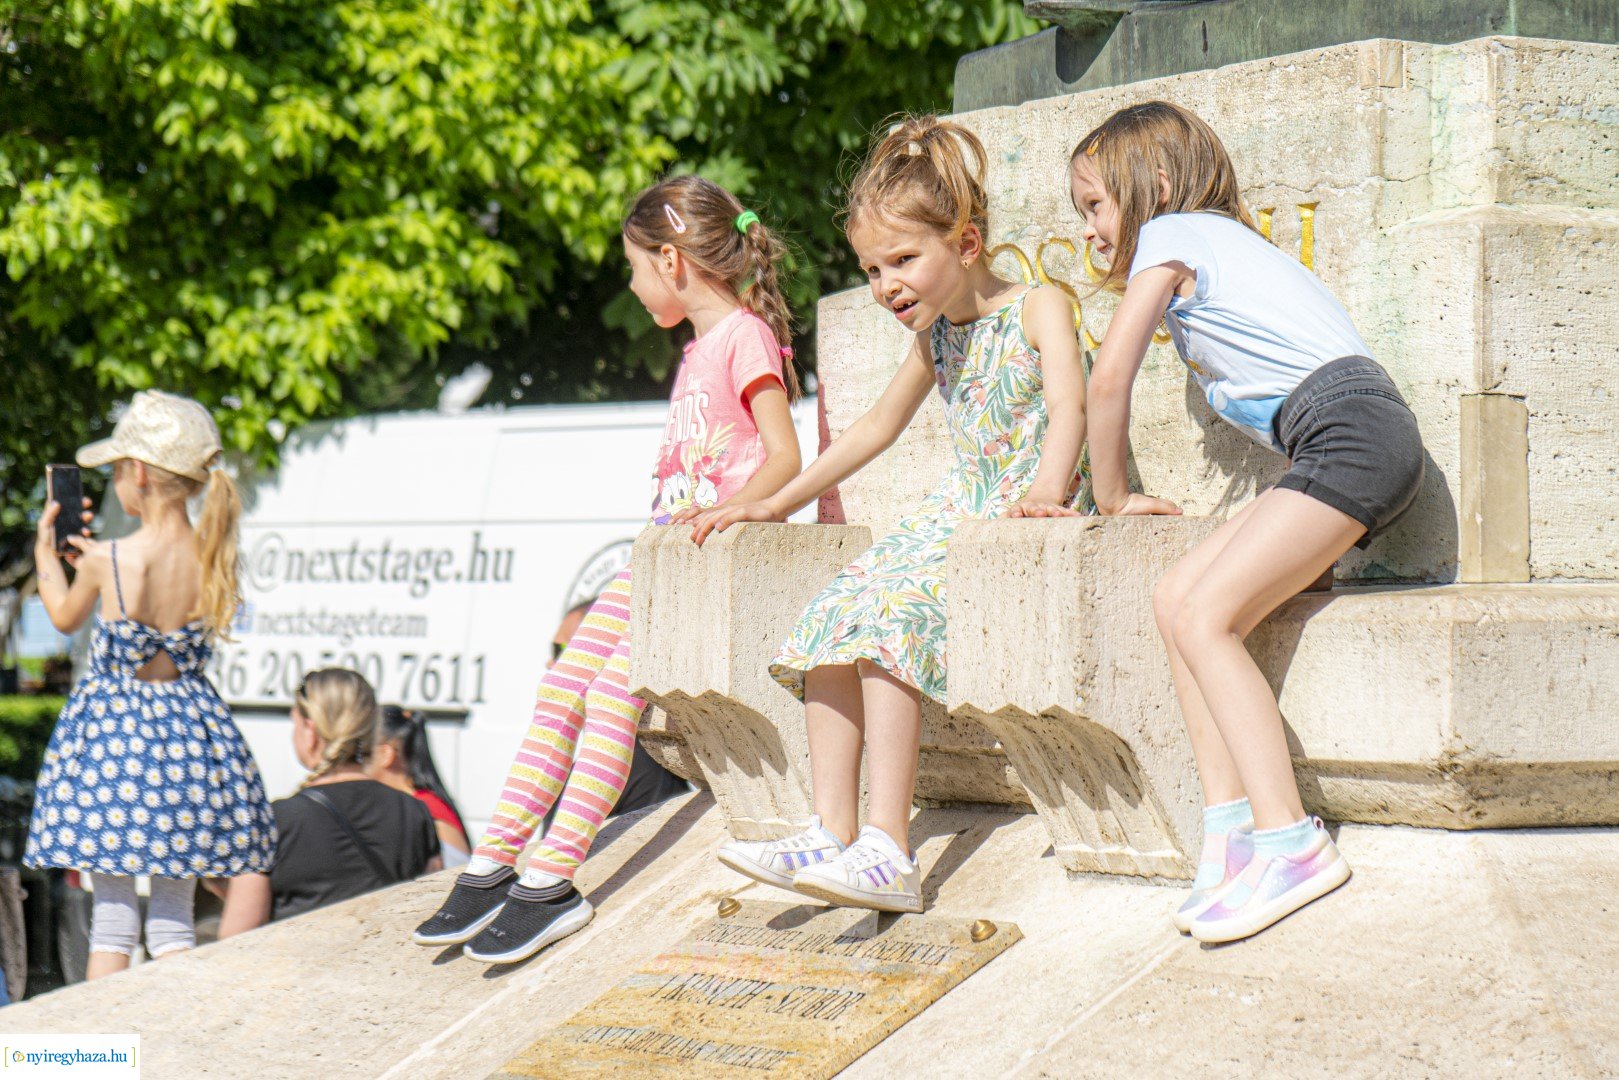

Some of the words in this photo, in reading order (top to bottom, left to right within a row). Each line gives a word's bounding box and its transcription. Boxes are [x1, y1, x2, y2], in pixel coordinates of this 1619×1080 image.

[238, 529, 515, 598] @nextstage.hu
[256, 606, 428, 646] nextstageteam
[258, 650, 303, 698] 20
[399, 651, 488, 704] 7611
[661, 972, 776, 1009] KOSSUTH
[766, 984, 867, 1020] SZOBOR
